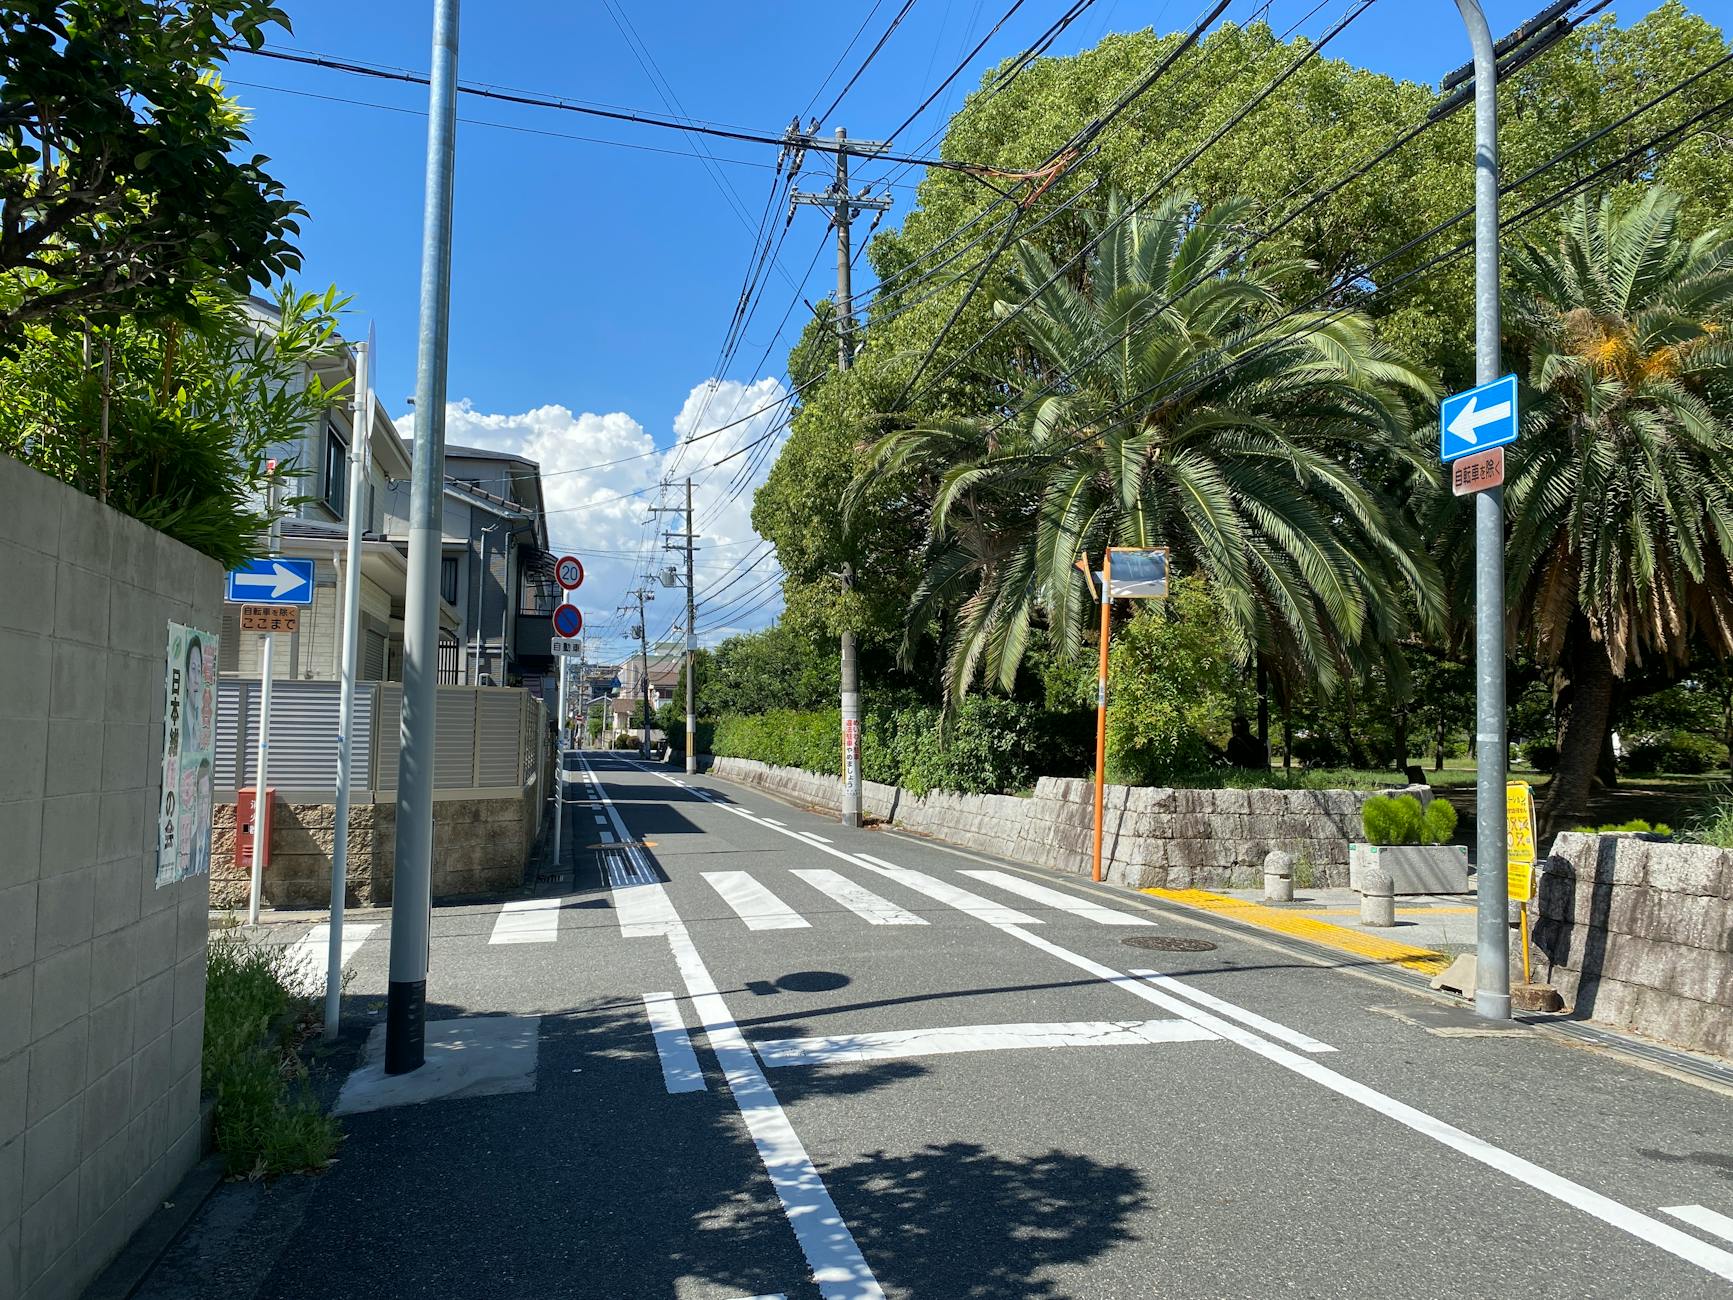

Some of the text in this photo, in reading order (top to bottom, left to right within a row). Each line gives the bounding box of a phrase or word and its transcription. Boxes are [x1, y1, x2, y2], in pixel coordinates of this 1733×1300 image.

[1456, 459, 1500, 487] 自転車を除く
[562, 566, 577, 580] 20
[244, 607, 295, 616] 自転車を除く
[243, 617, 296, 630] ここまで
[554, 642, 579, 652] 自動車
